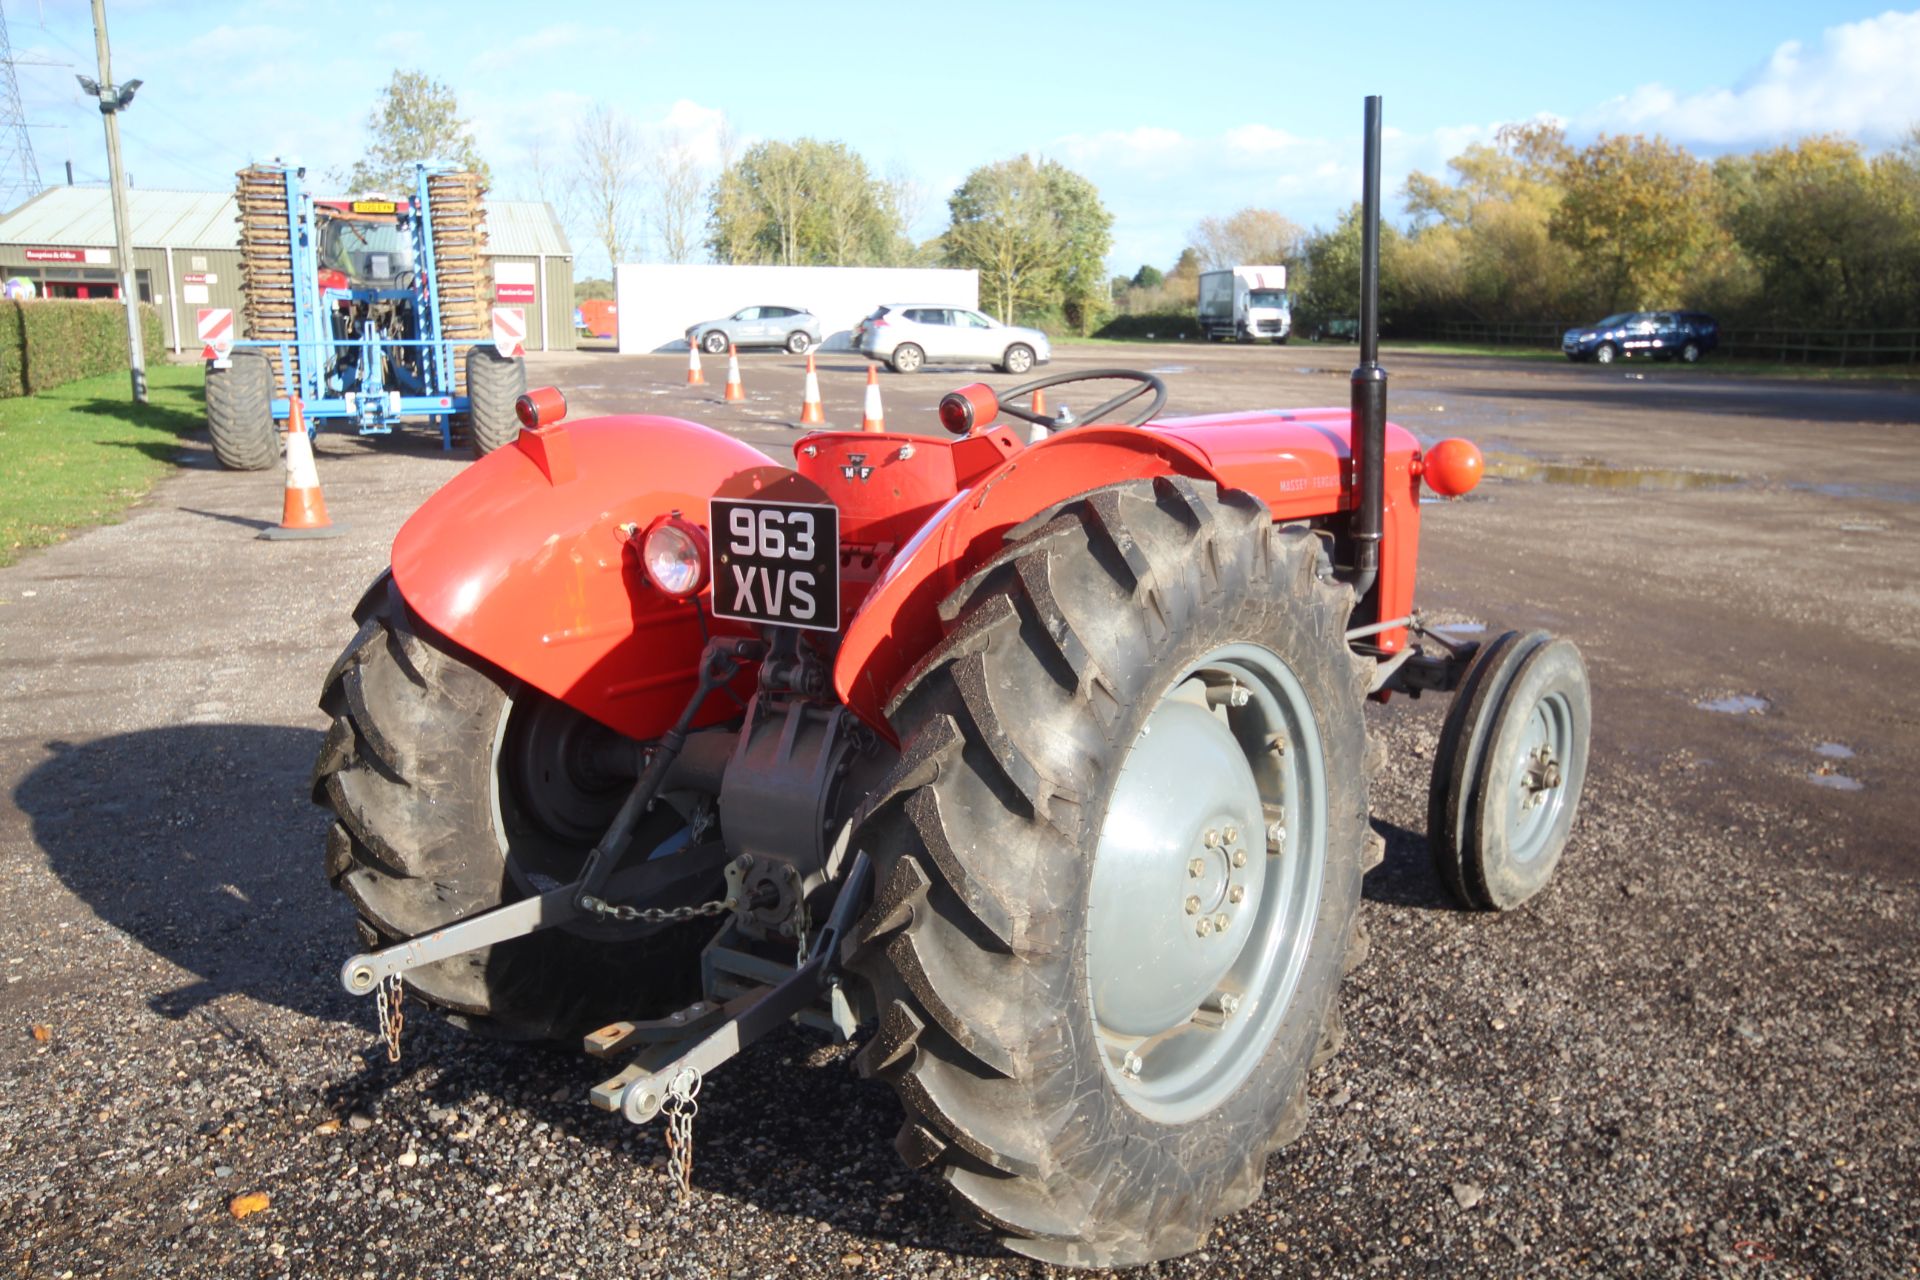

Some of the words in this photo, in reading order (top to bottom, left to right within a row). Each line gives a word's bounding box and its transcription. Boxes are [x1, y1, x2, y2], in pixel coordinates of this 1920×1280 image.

[845, 467, 854, 478] M
[861, 467, 870, 478] F
[1280, 478, 1308, 492] MASSEY
[729, 507, 815, 561] 963
[731, 564, 816, 619] XVS
